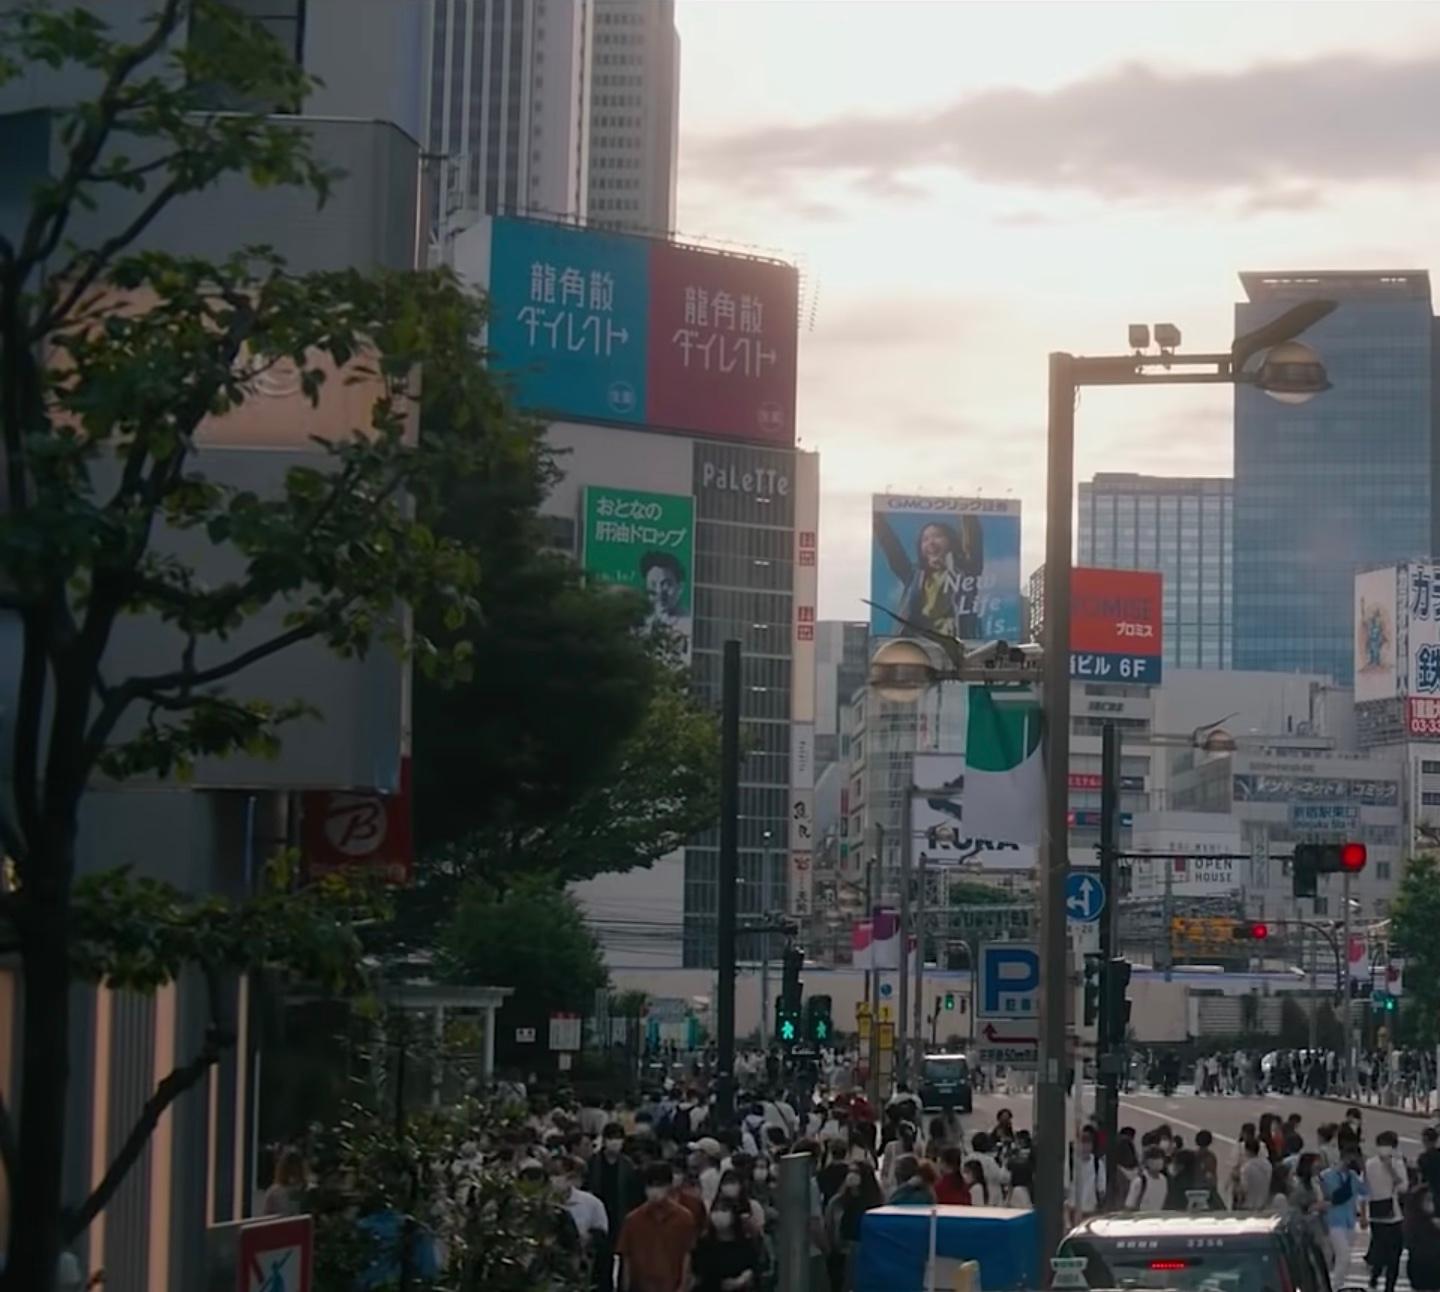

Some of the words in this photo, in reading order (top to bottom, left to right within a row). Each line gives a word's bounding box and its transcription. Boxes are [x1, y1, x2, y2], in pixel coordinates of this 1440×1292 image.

[530, 261, 615, 312] 龍角散
[683, 286, 764, 334] 龍角散
[517, 306, 629, 356] ダイレクト
[671, 328, 777, 378] ダイレクト
[596, 497, 663, 521] おとなの
[595, 520, 687, 548] 肝油ドロップ
[943, 571, 996, 594] New
[958, 596, 1001, 619] Life
[1115, 621, 1154, 638] プロミス
[1069, 654, 1111, 676] ビル
[1119, 657, 1147, 678] 6F
[1194, 857, 1233, 870] OPEN
[1194, 872, 1233, 883] HOUSE
[985, 949, 1040, 1012] P
